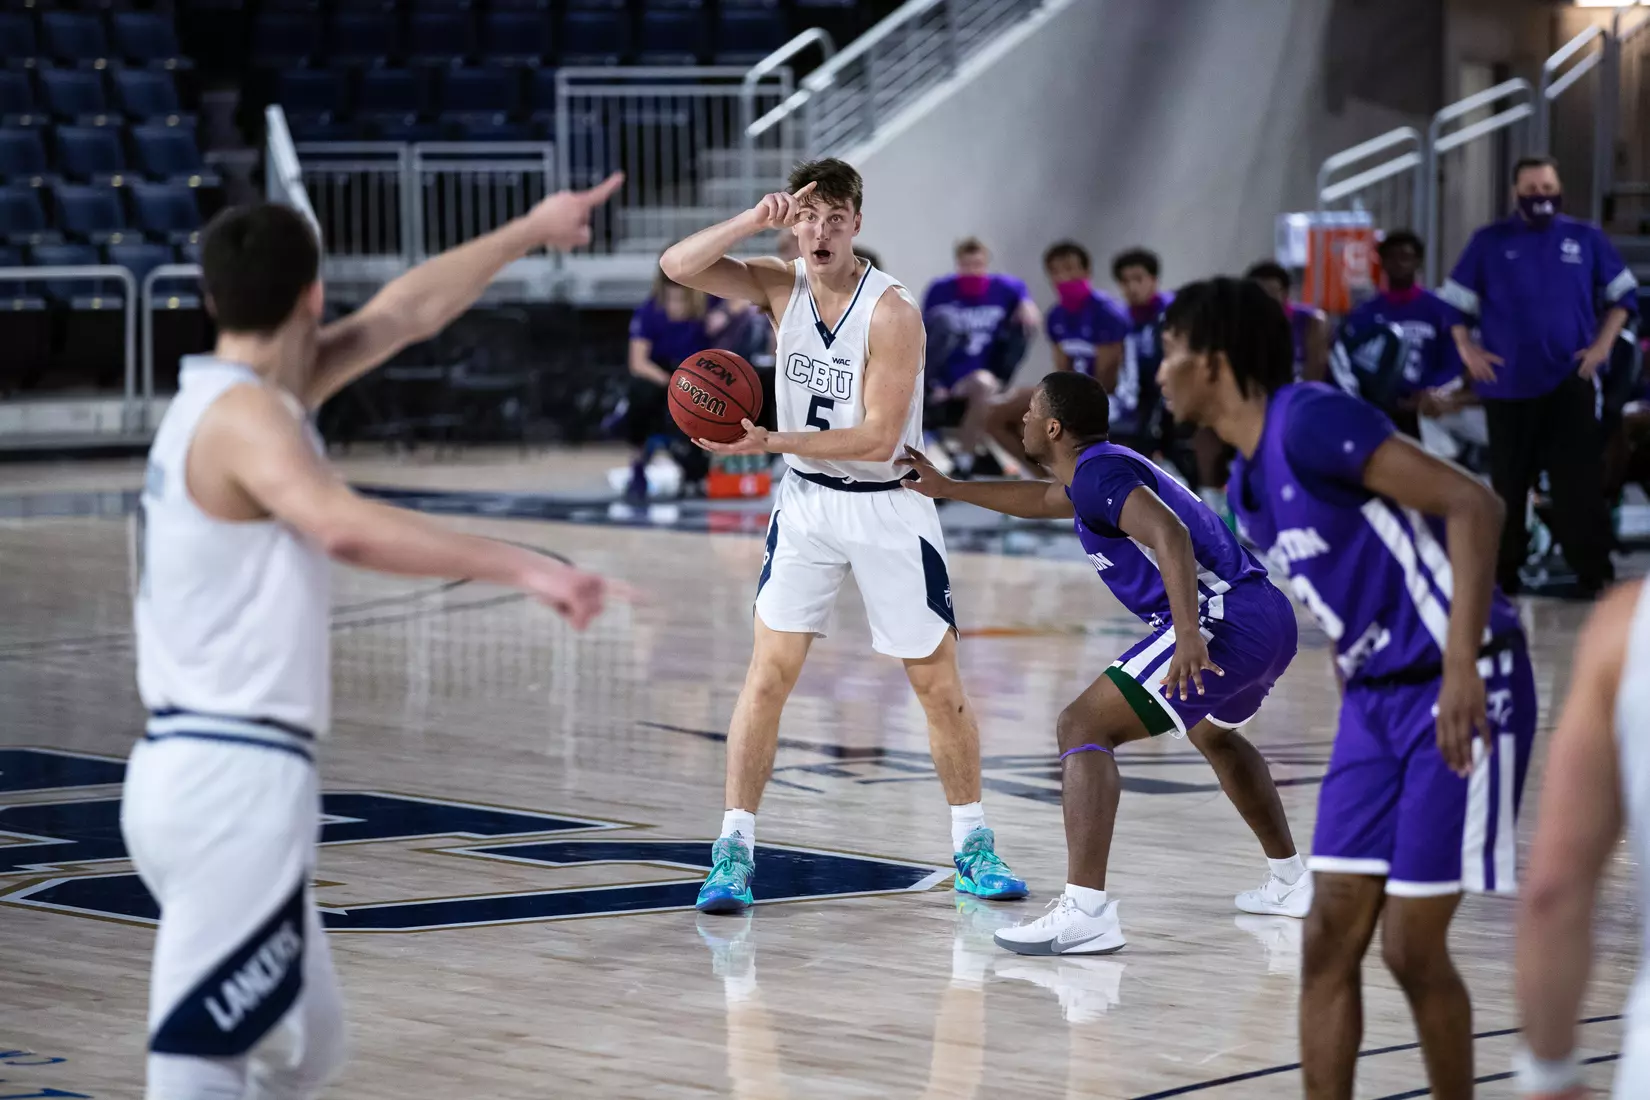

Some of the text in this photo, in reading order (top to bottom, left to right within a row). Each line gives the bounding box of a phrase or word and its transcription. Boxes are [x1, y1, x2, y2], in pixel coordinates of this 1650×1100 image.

[695, 357, 737, 387] NCAA
[785, 352, 853, 401] CBU
[831, 356, 851, 367] WAC
[676, 375, 727, 418] Wilson
[805, 395, 835, 431] 5
